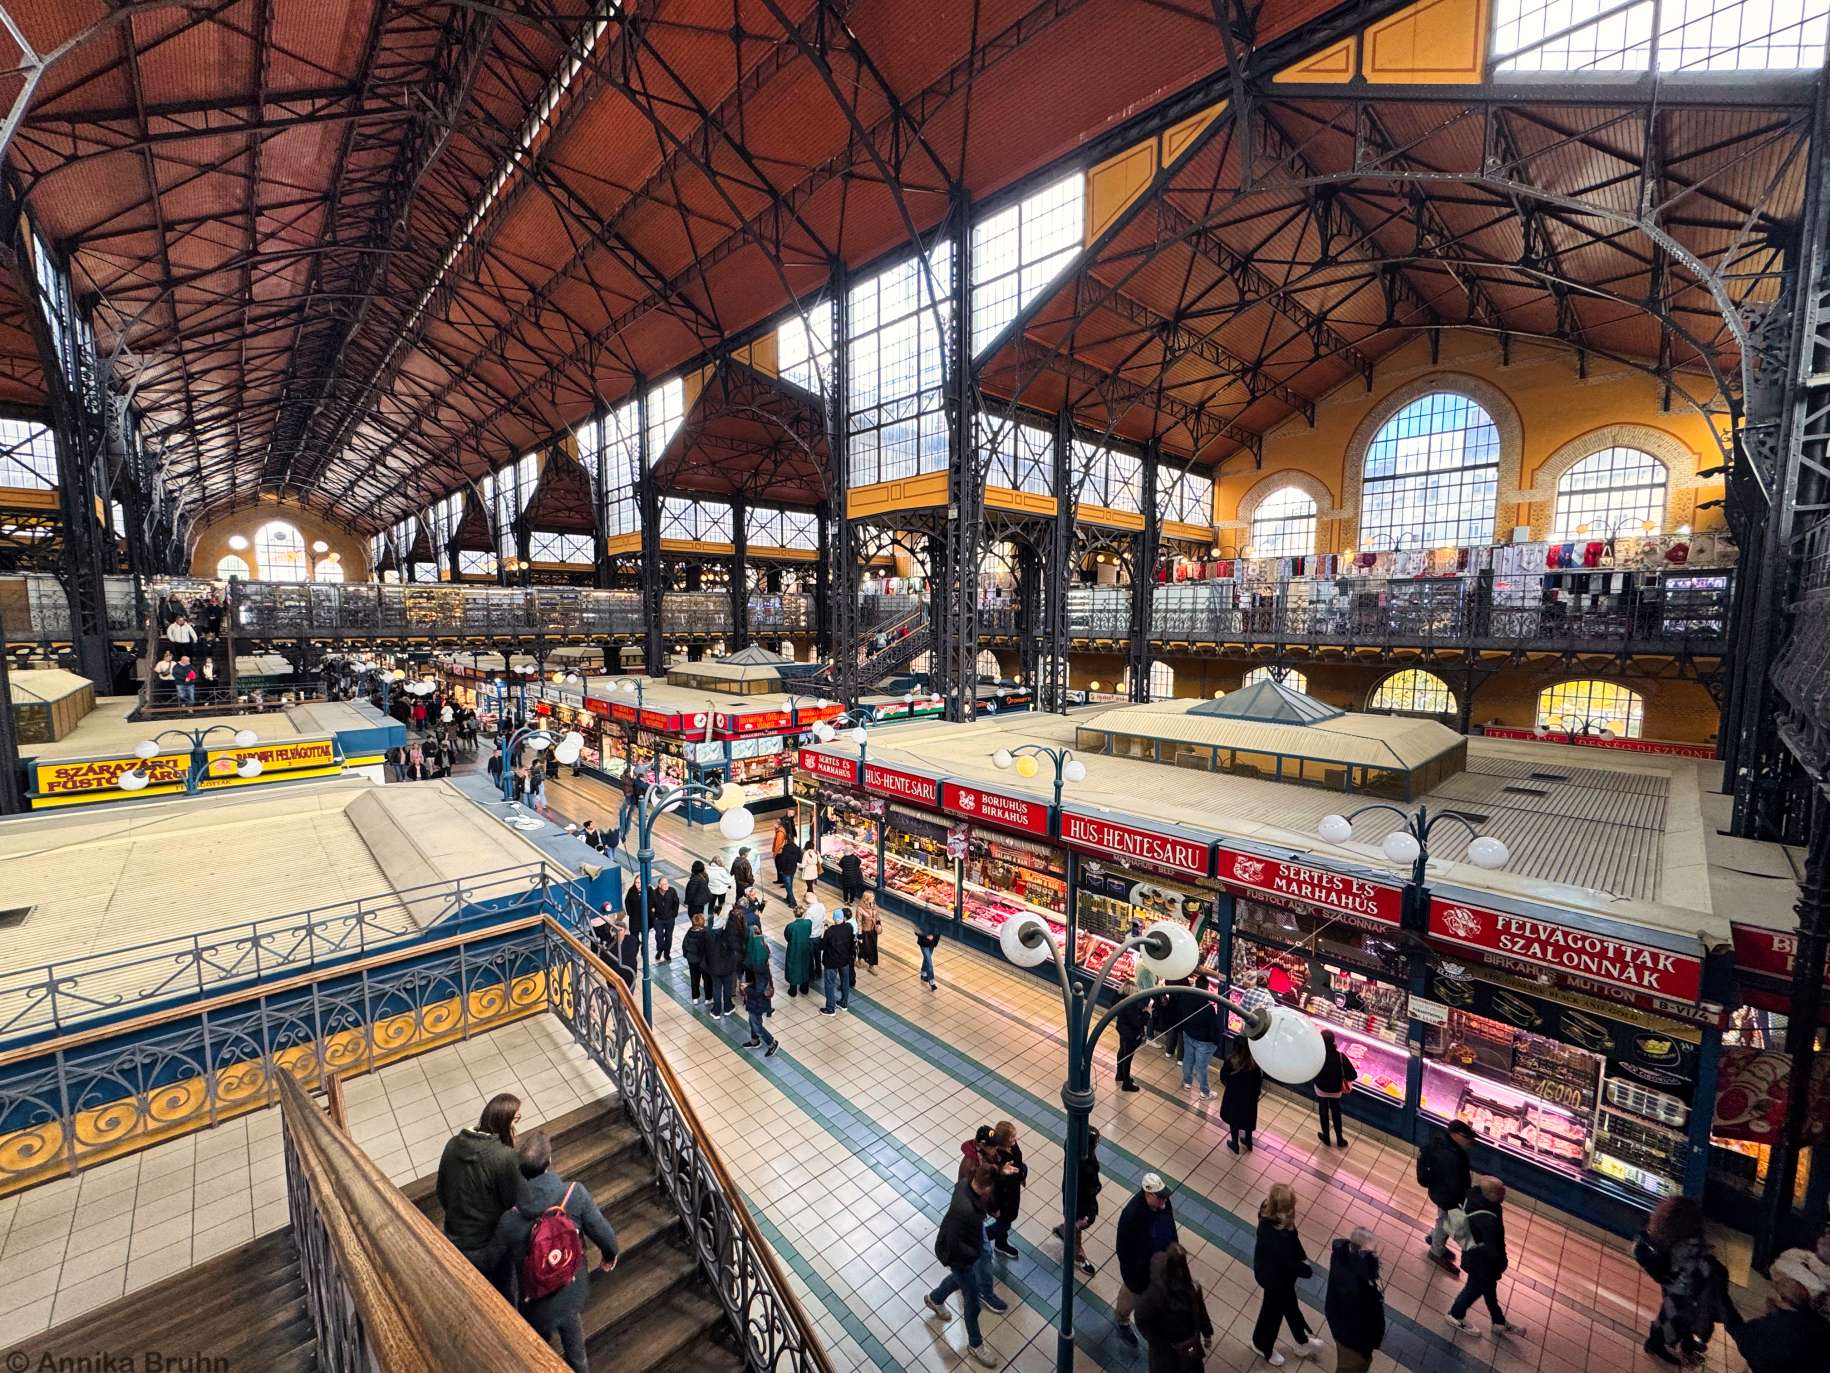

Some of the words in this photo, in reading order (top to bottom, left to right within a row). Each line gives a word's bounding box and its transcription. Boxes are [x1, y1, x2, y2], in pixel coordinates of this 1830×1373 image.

[864, 766, 936, 800] HÚS-HENTESÁRU
[981, 804, 1029, 825] BIRKAHÚS
[1070, 817, 1200, 869] HÚS-HENTESÁRU
[1273, 877, 1378, 915] MARHAHÚS
[1279, 863, 1343, 890] SERTÉS
[1352, 877, 1375, 897] ÉS
[1496, 915, 1677, 974] FELVÁGOTTAK
[1499, 935, 1661, 990] SZALONNÁK
[1566, 975, 1637, 1003] MUTTON
[1607, 1005, 1639, 1021] GOLD
